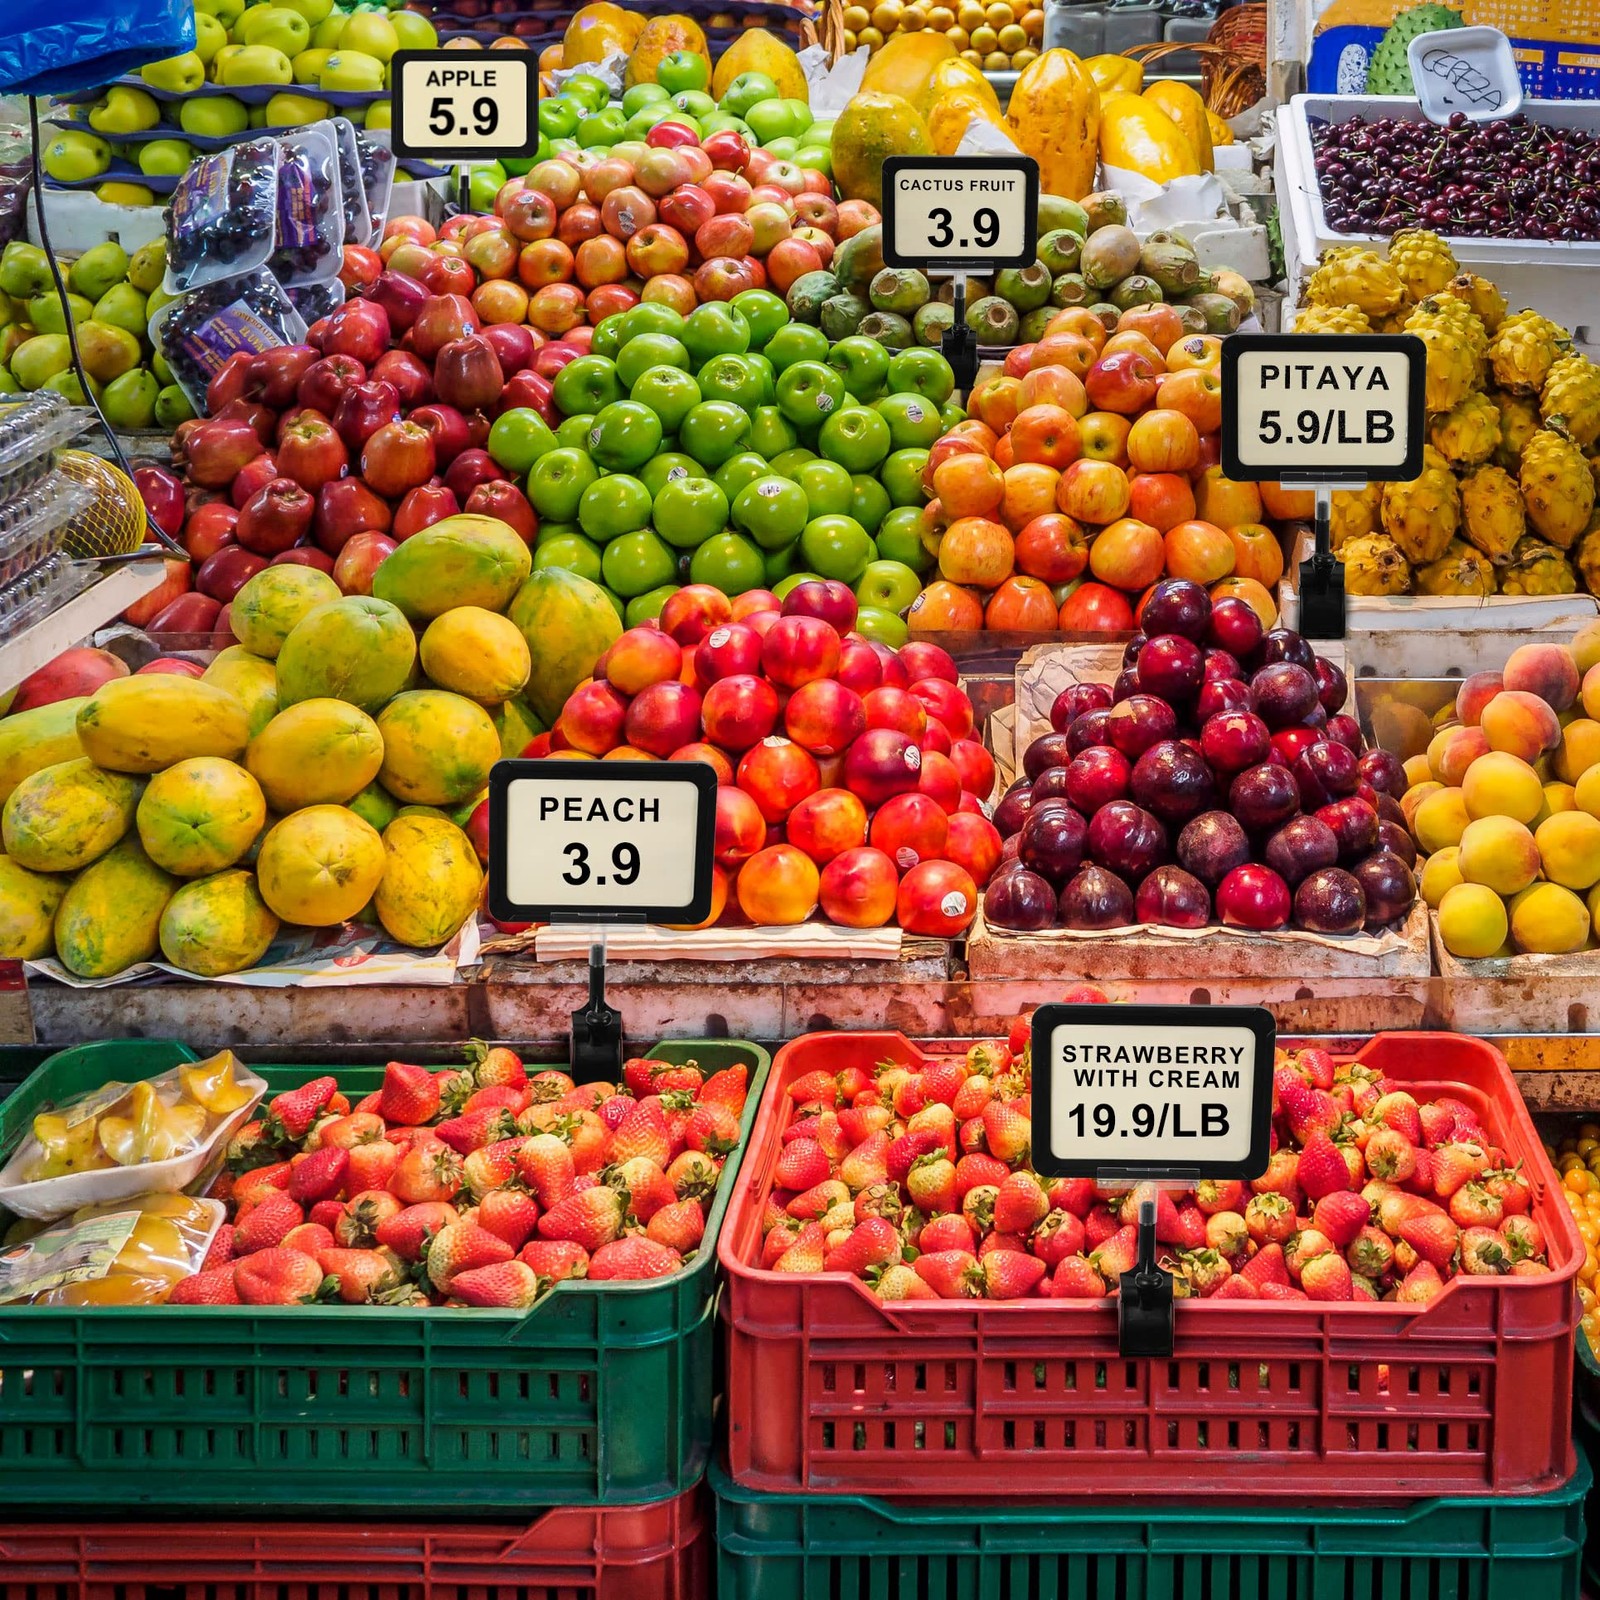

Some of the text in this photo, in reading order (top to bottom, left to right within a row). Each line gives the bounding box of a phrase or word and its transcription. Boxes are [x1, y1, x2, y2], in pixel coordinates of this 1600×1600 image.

[426, 70, 497, 87] APPLE
[429, 96, 500, 136] 5.9
[900, 179, 1016, 191] CACTUS FRUIT
[927, 206, 1001, 248] 3.9
[1260, 364, 1390, 391] PITAYA
[1258, 409, 1395, 446] 5.9/LB
[540, 796, 660, 823] PEACH
[562, 841, 641, 886] 3.9
[1062, 1044, 1245, 1065] STRAWBERRY
[1073, 1068, 1240, 1089] WITH CREAM
[1067, 1102, 1231, 1139] 19.9/LB
